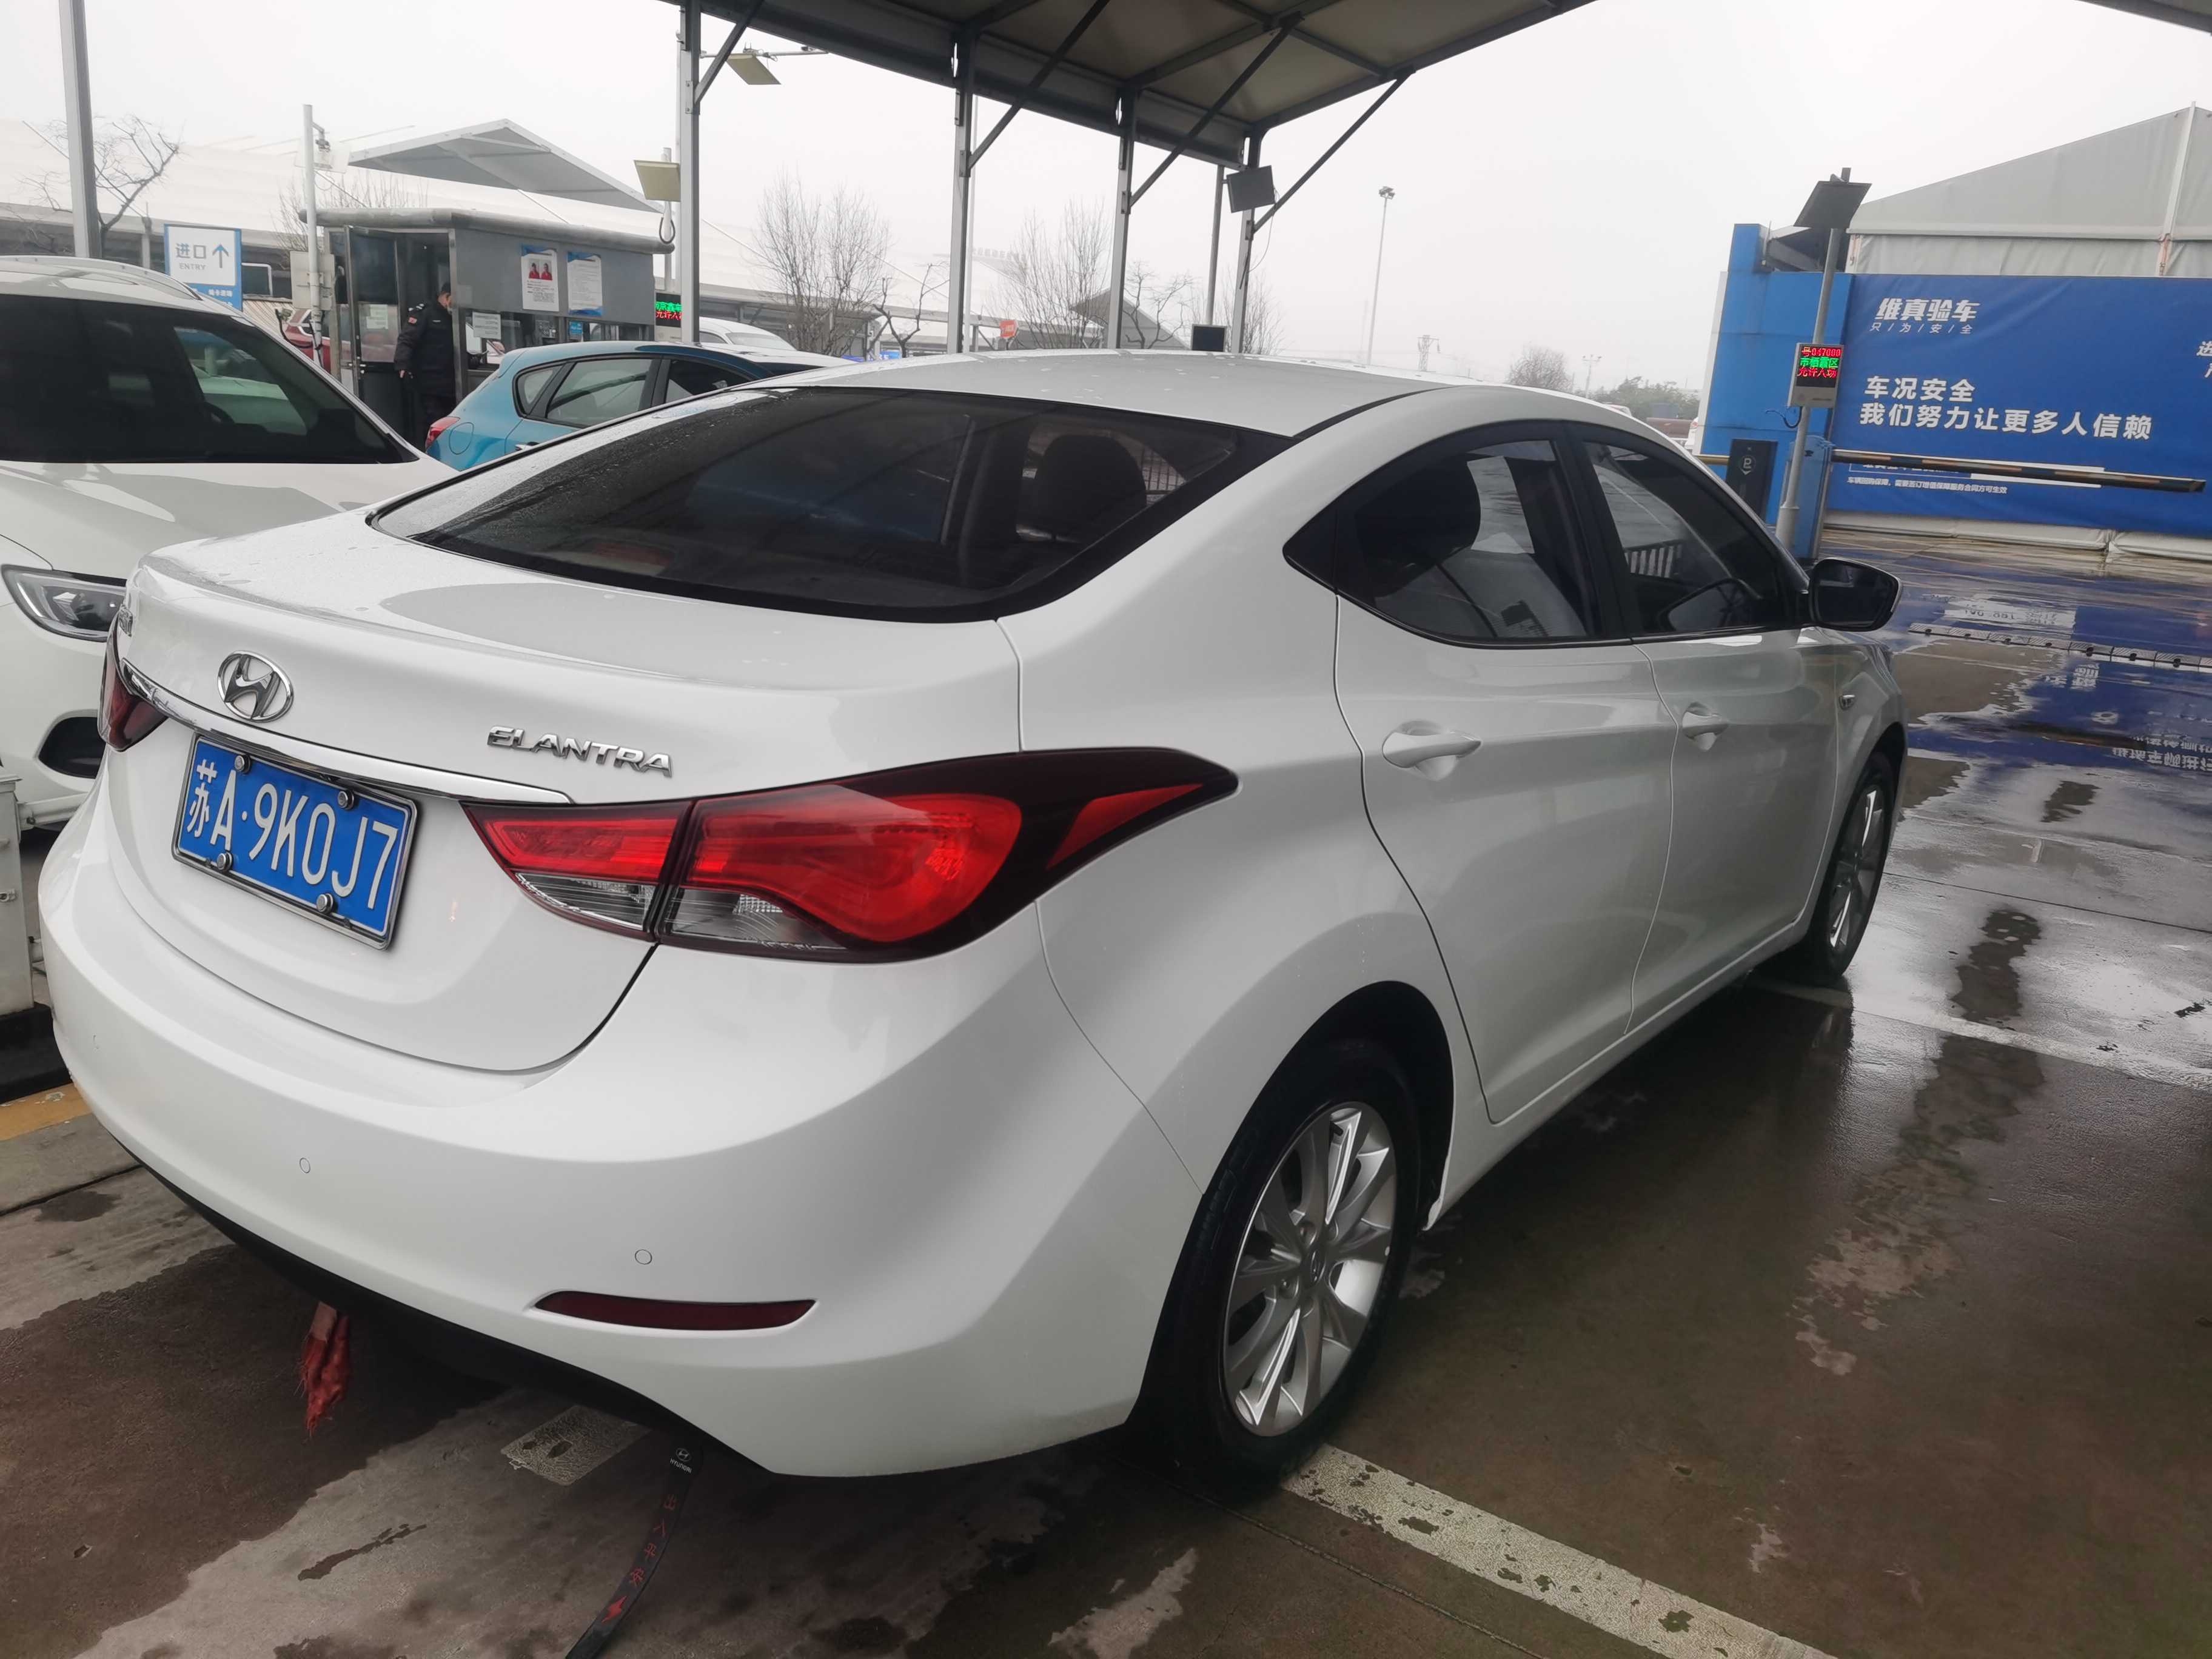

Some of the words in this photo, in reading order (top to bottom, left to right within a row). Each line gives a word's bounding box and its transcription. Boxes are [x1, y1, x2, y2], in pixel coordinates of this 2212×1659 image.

[175, 243, 206, 259] 进口
[1875, 298, 1980, 321] 维真验车
[1865, 376, 1976, 402] 车况安全
[1859, 402, 2152, 440] 我们努力让更多人信赖
[487, 725, 672, 778] ELANTRA
[669, 1458, 692, 1474] HYUNDAI
